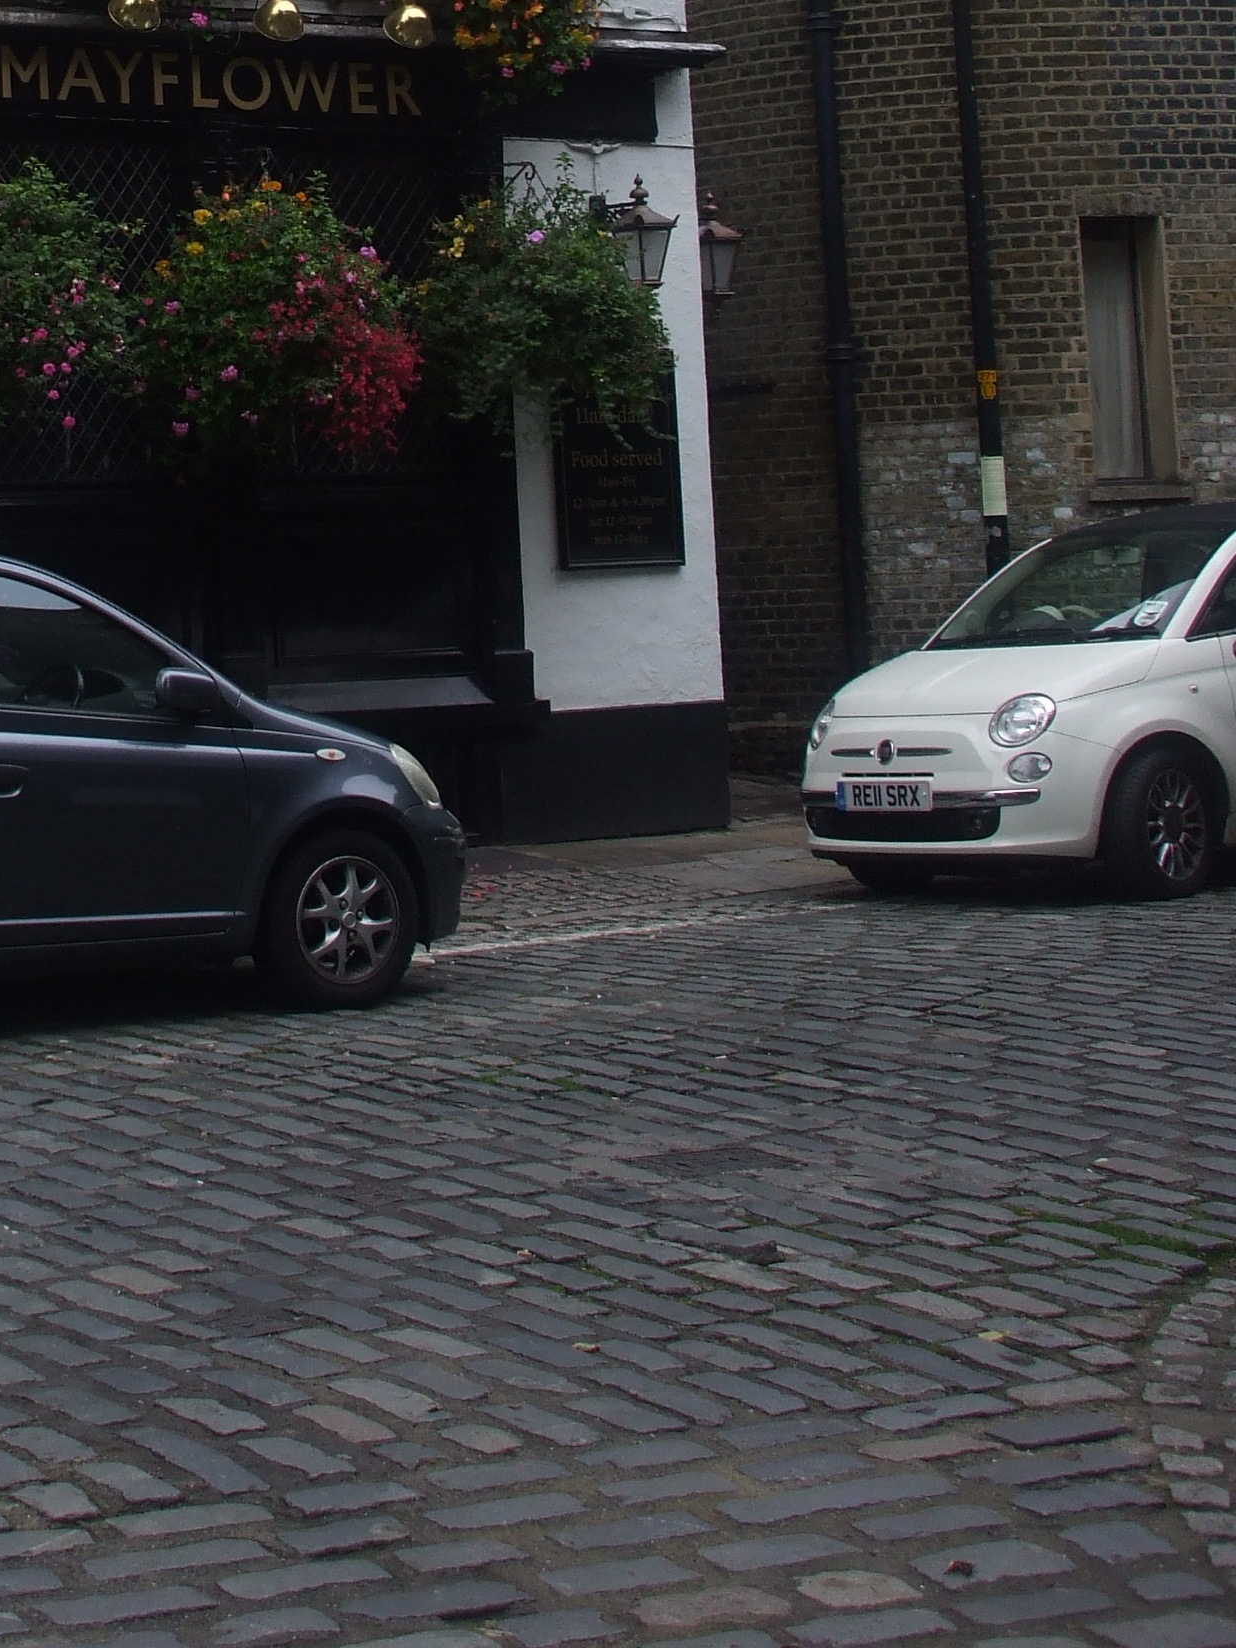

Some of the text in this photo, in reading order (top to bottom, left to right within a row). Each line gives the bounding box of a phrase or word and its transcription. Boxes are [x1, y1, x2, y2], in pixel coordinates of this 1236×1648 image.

[0, 42, 423, 117] MAYFLOWER
[571, 447, 663, 468] Food served
[886, 784, 921, 807] SRX
